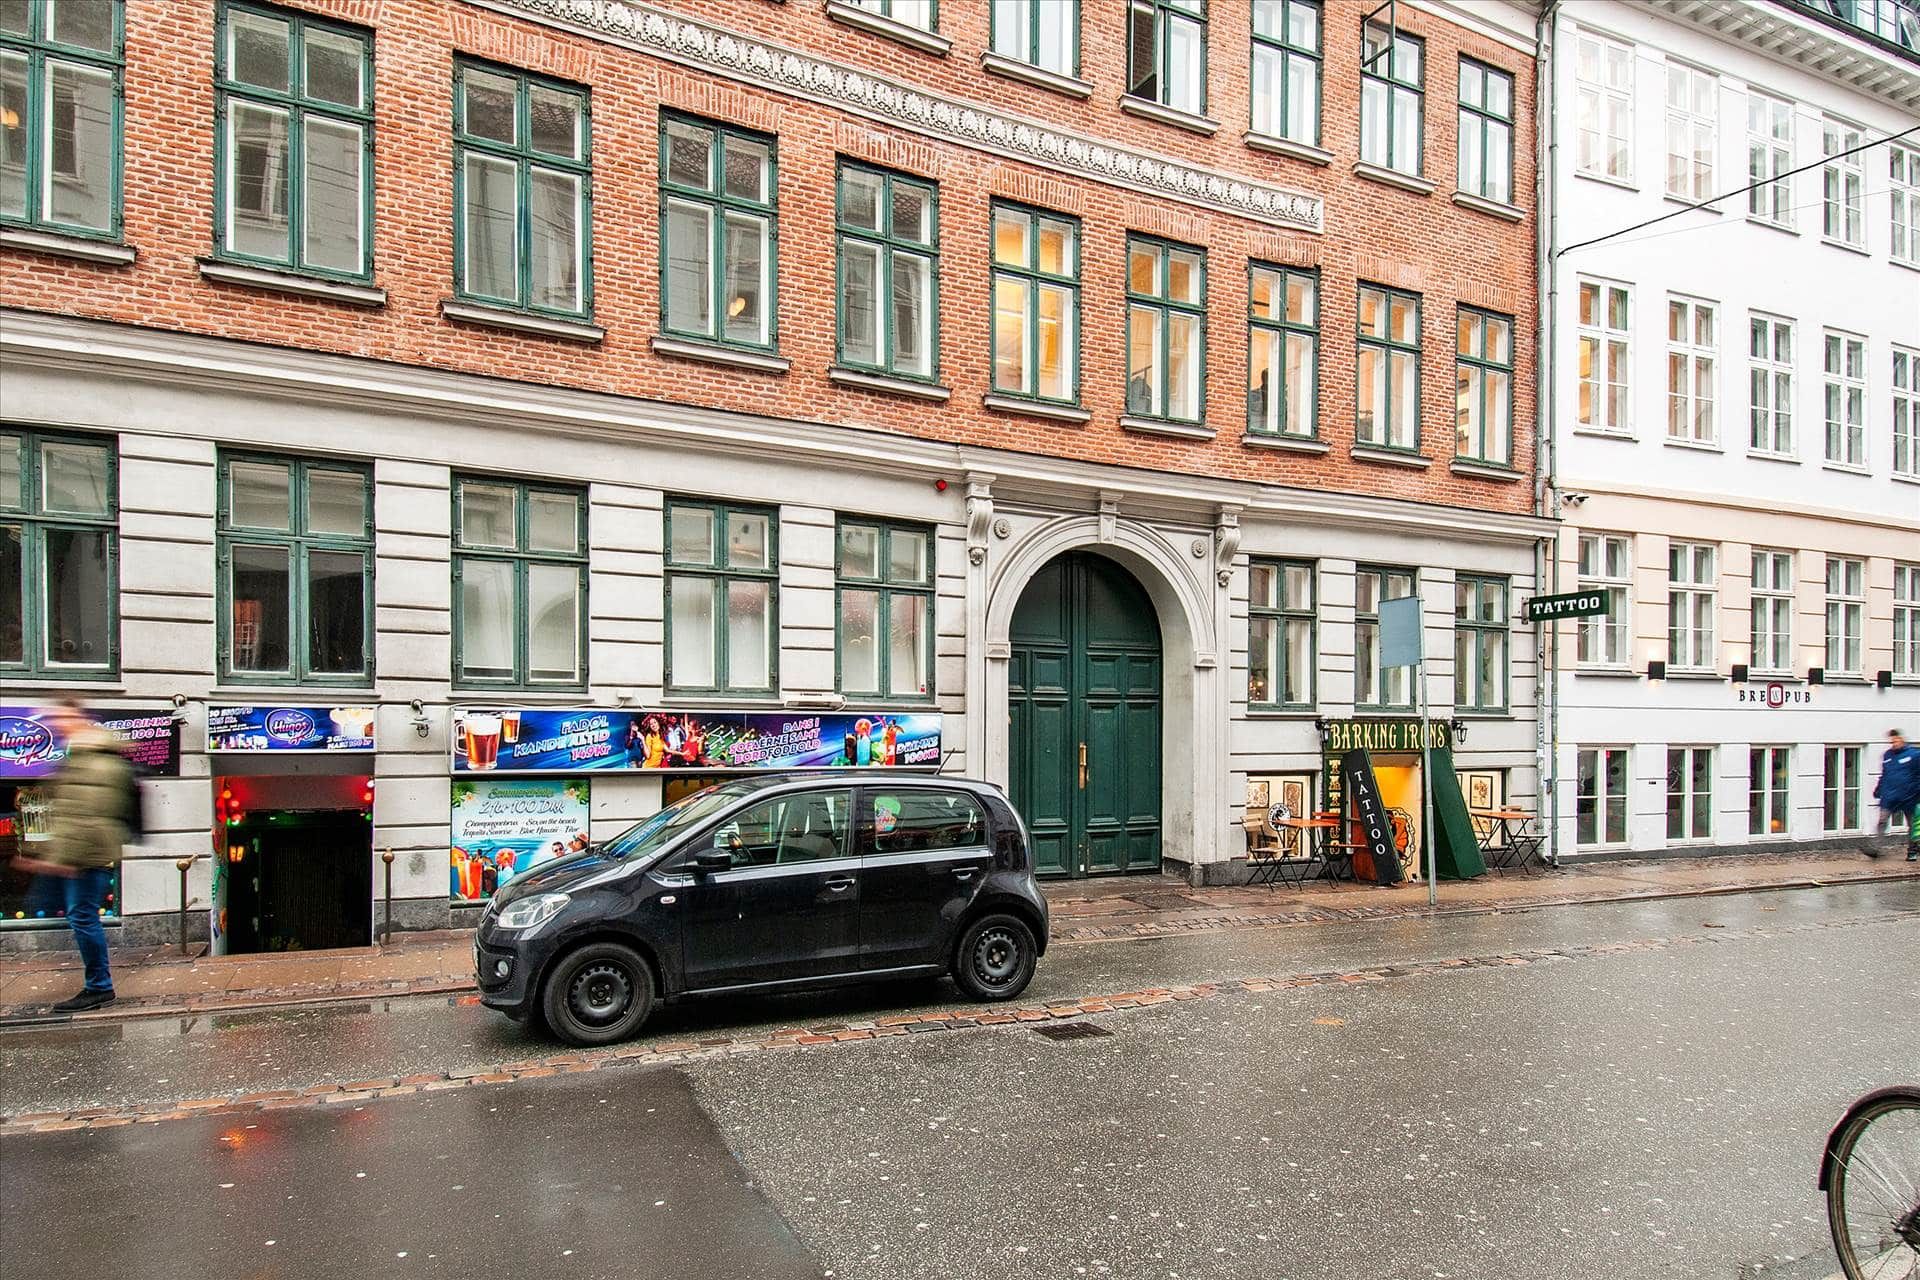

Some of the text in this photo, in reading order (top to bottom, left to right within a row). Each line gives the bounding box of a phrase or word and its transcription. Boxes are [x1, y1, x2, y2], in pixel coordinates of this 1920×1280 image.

[1533, 596, 1600, 614] TATTOO
[131, 729, 155, 740] 100
[272, 720, 309, 736] Hugos
[783, 718, 812, 733] DANS
[729, 728, 821, 755] SOFAERNE SAMT
[896, 736, 939, 754] DRINKS
[1330, 723, 1397, 749] BARKING
[734, 739, 821, 765] BORDFODBOLD
[510, 799, 537, 814] 100
[1354, 770, 1386, 855] TATTOO
